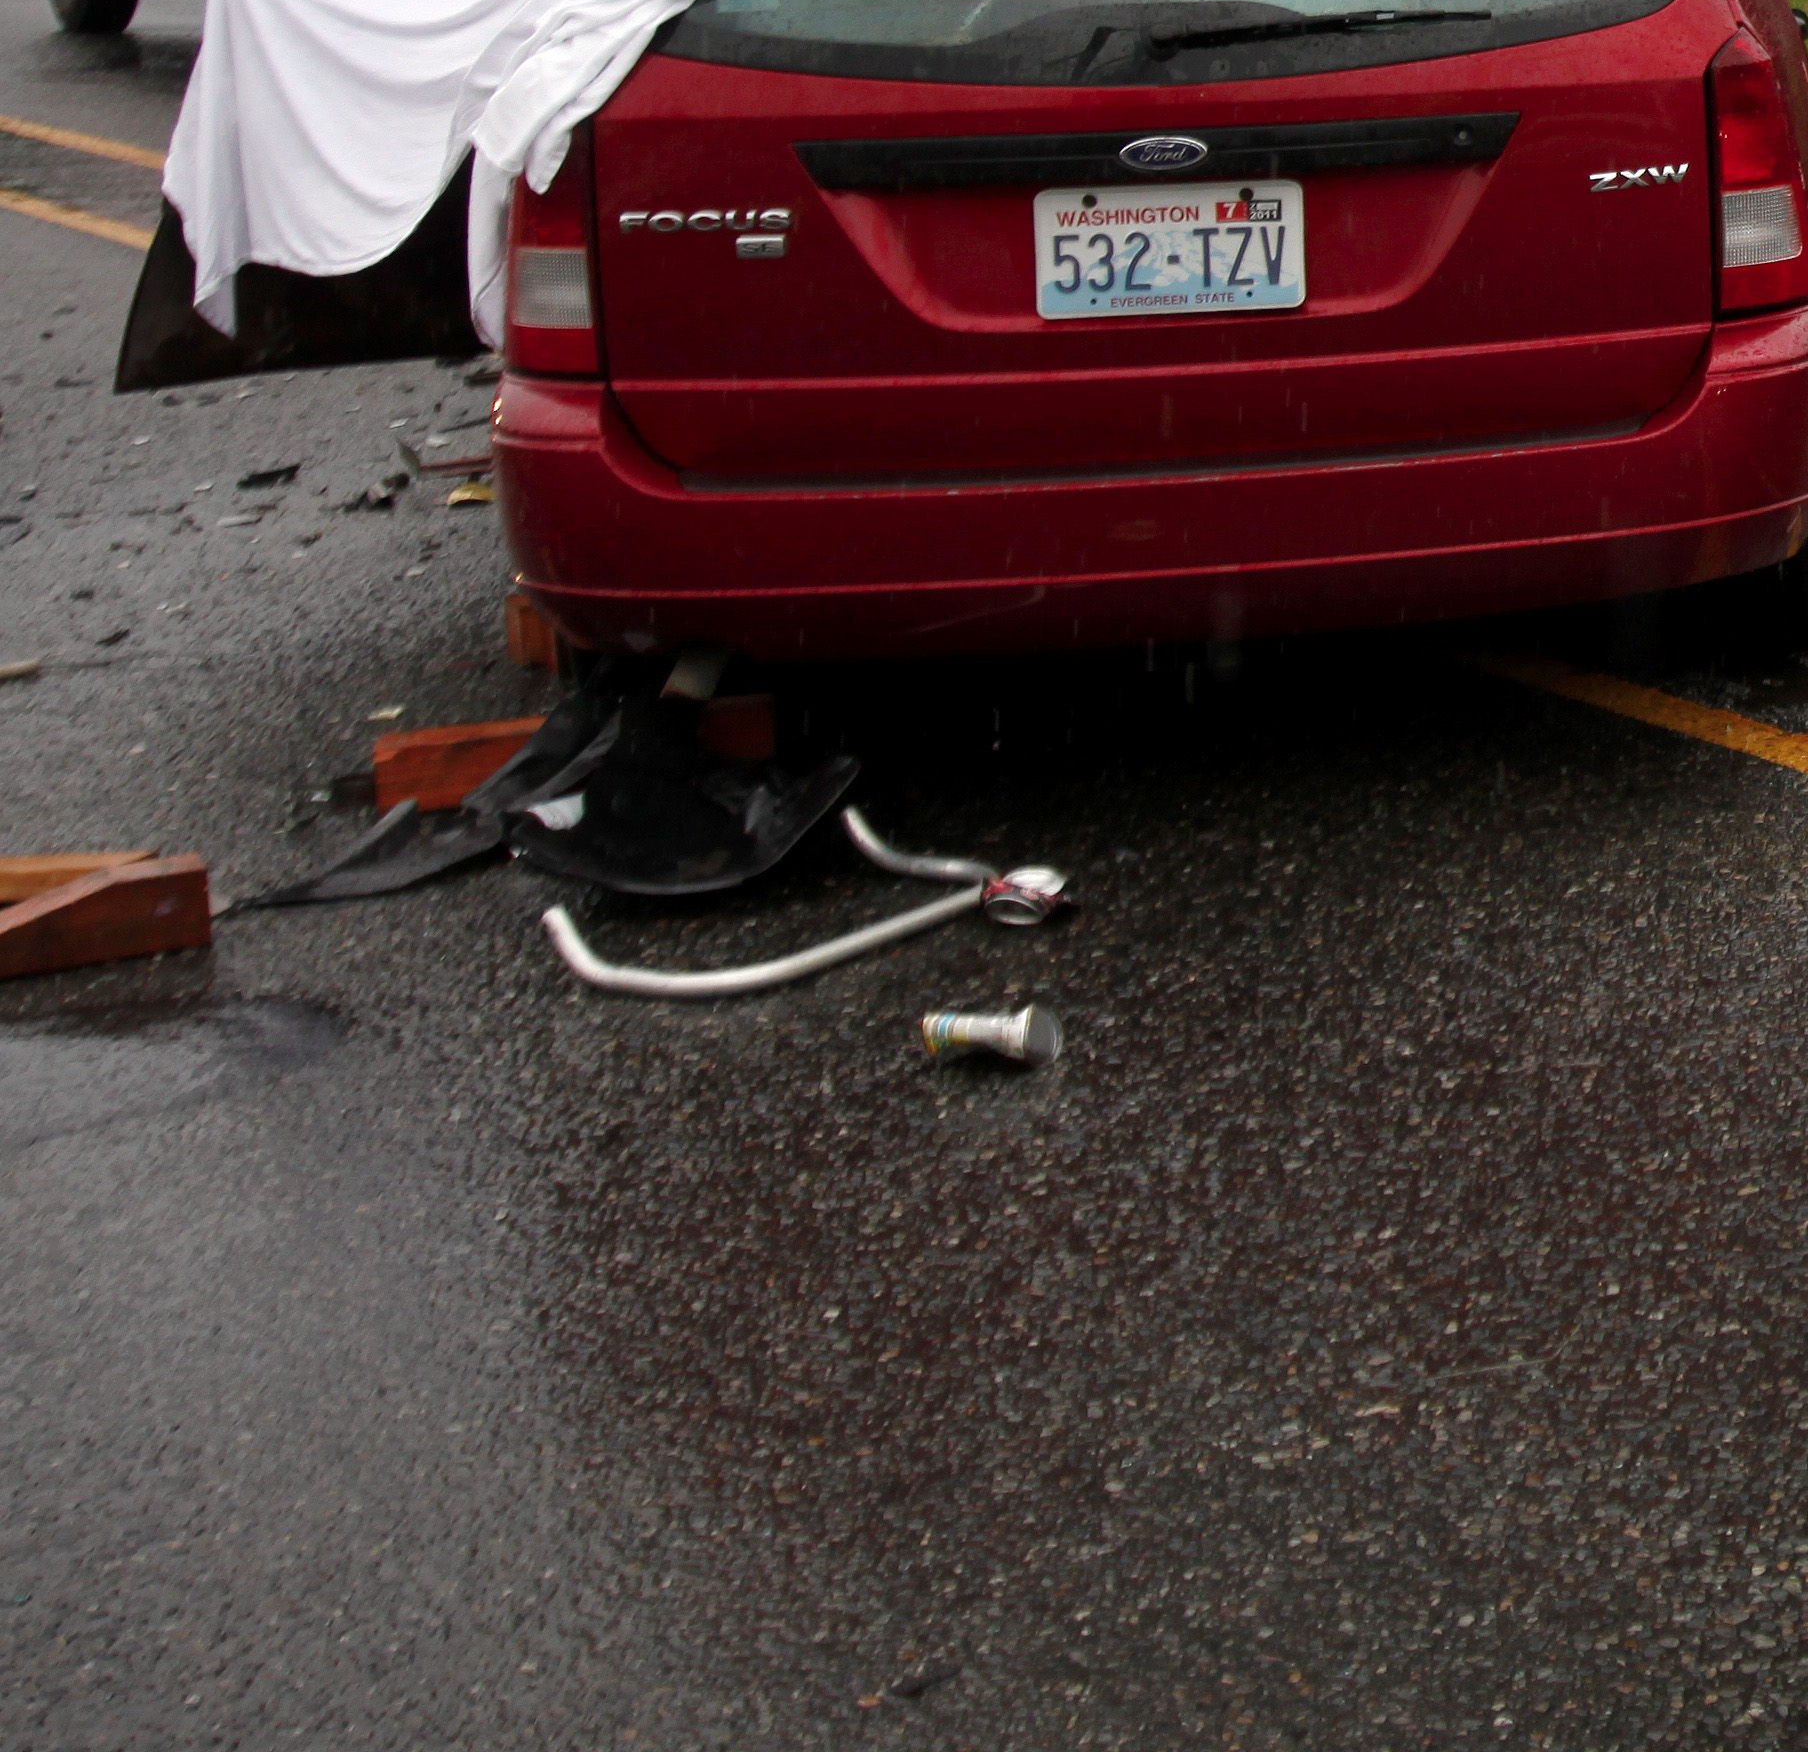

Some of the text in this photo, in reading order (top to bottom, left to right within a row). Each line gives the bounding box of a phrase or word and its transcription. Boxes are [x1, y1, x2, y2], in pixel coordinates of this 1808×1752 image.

[1138, 142, 1188, 164] Ford
[1589, 162, 1689, 193] ZXW
[618, 208, 793, 233] FOCUS
[1056, 205, 1200, 228] WASHINGTON
[1223, 202, 1238, 219] 7
[1248, 209, 1278, 221] 2011
[1110, 291, 1236, 309] EVERGREEN STATE
